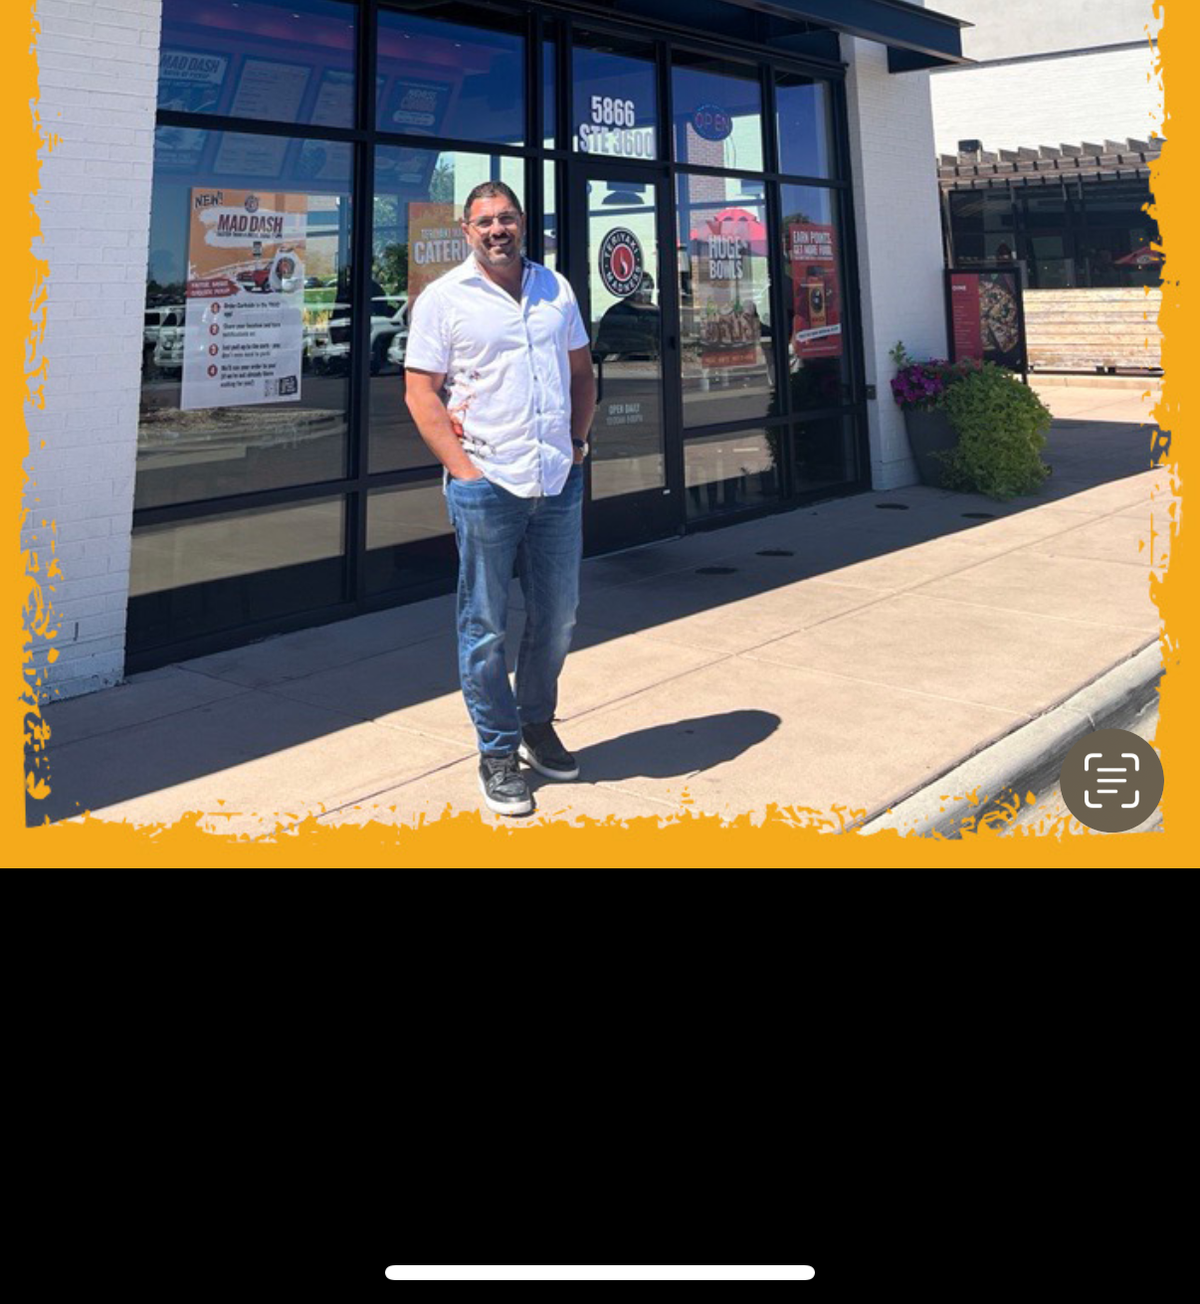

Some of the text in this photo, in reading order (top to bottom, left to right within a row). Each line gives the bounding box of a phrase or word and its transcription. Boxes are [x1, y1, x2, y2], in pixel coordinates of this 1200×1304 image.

[188, 57, 220, 73] DASH
[591, 95, 635, 127] 5866
[695, 112, 730, 133] OPEN
[579, 124, 653, 158] STE 3600
[218, 214, 284, 233] MAD DASH
[604, 233, 639, 257] TERIYAKI
[793, 231, 808, 243] EARN
[414, 238, 471, 264] CATERI
[606, 266, 642, 293] MADNESS
[709, 260, 743, 279] BOWLS
